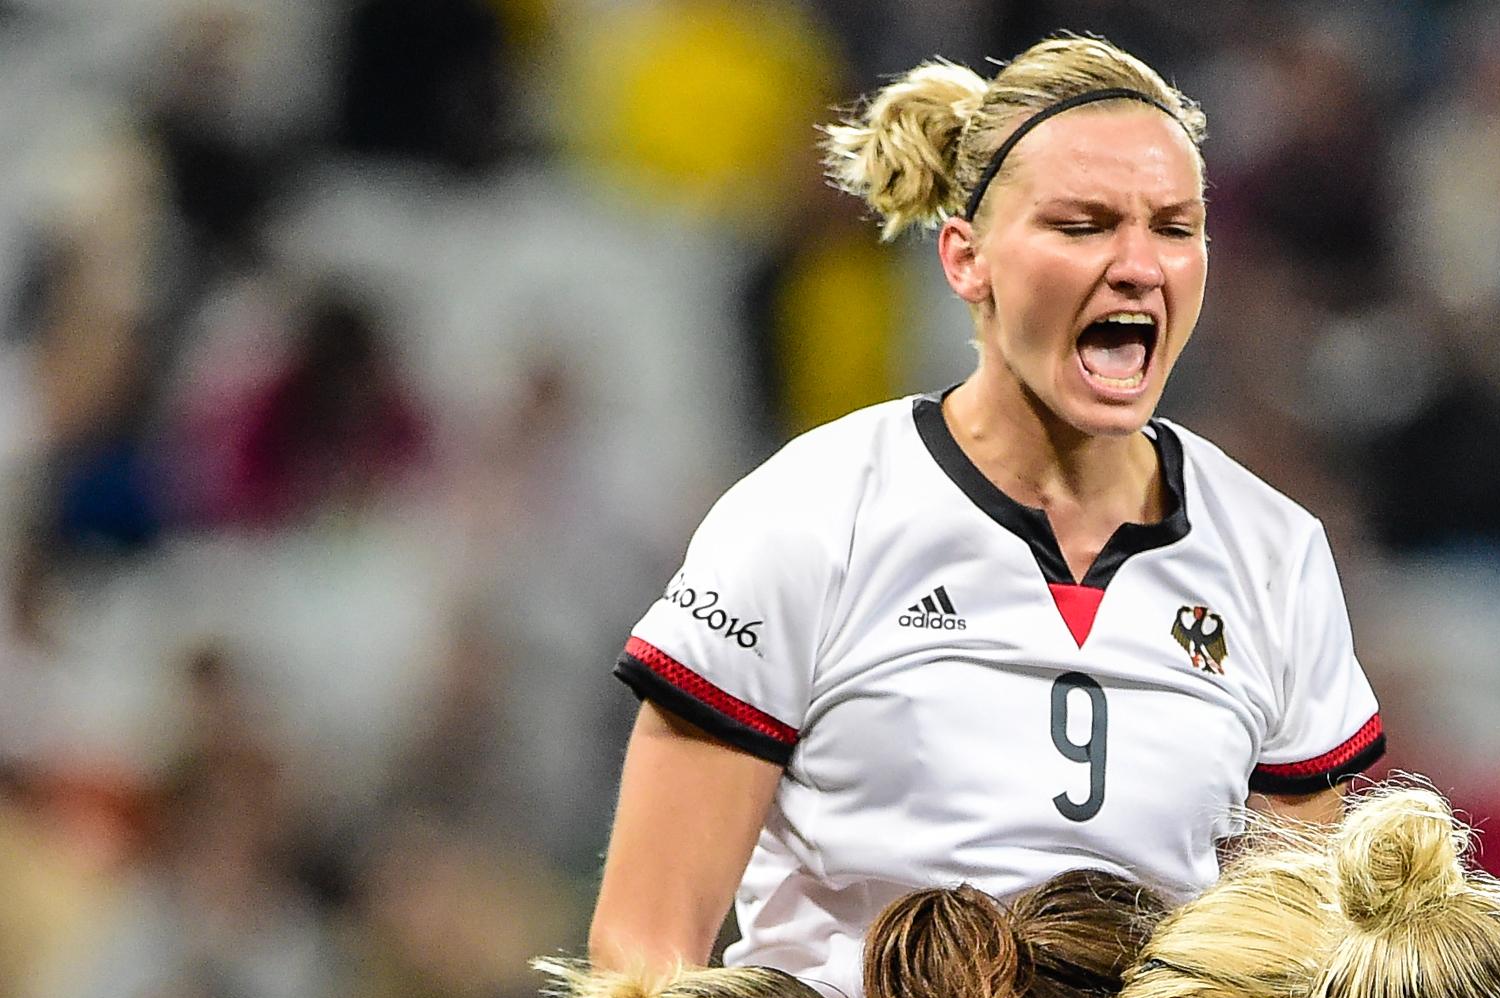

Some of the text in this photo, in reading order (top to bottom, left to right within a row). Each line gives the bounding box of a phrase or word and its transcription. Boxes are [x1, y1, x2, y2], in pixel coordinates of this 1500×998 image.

[664, 573, 763, 648] io2016
[898, 613, 967, 631] adidas
[1051, 671, 1107, 822] 9
